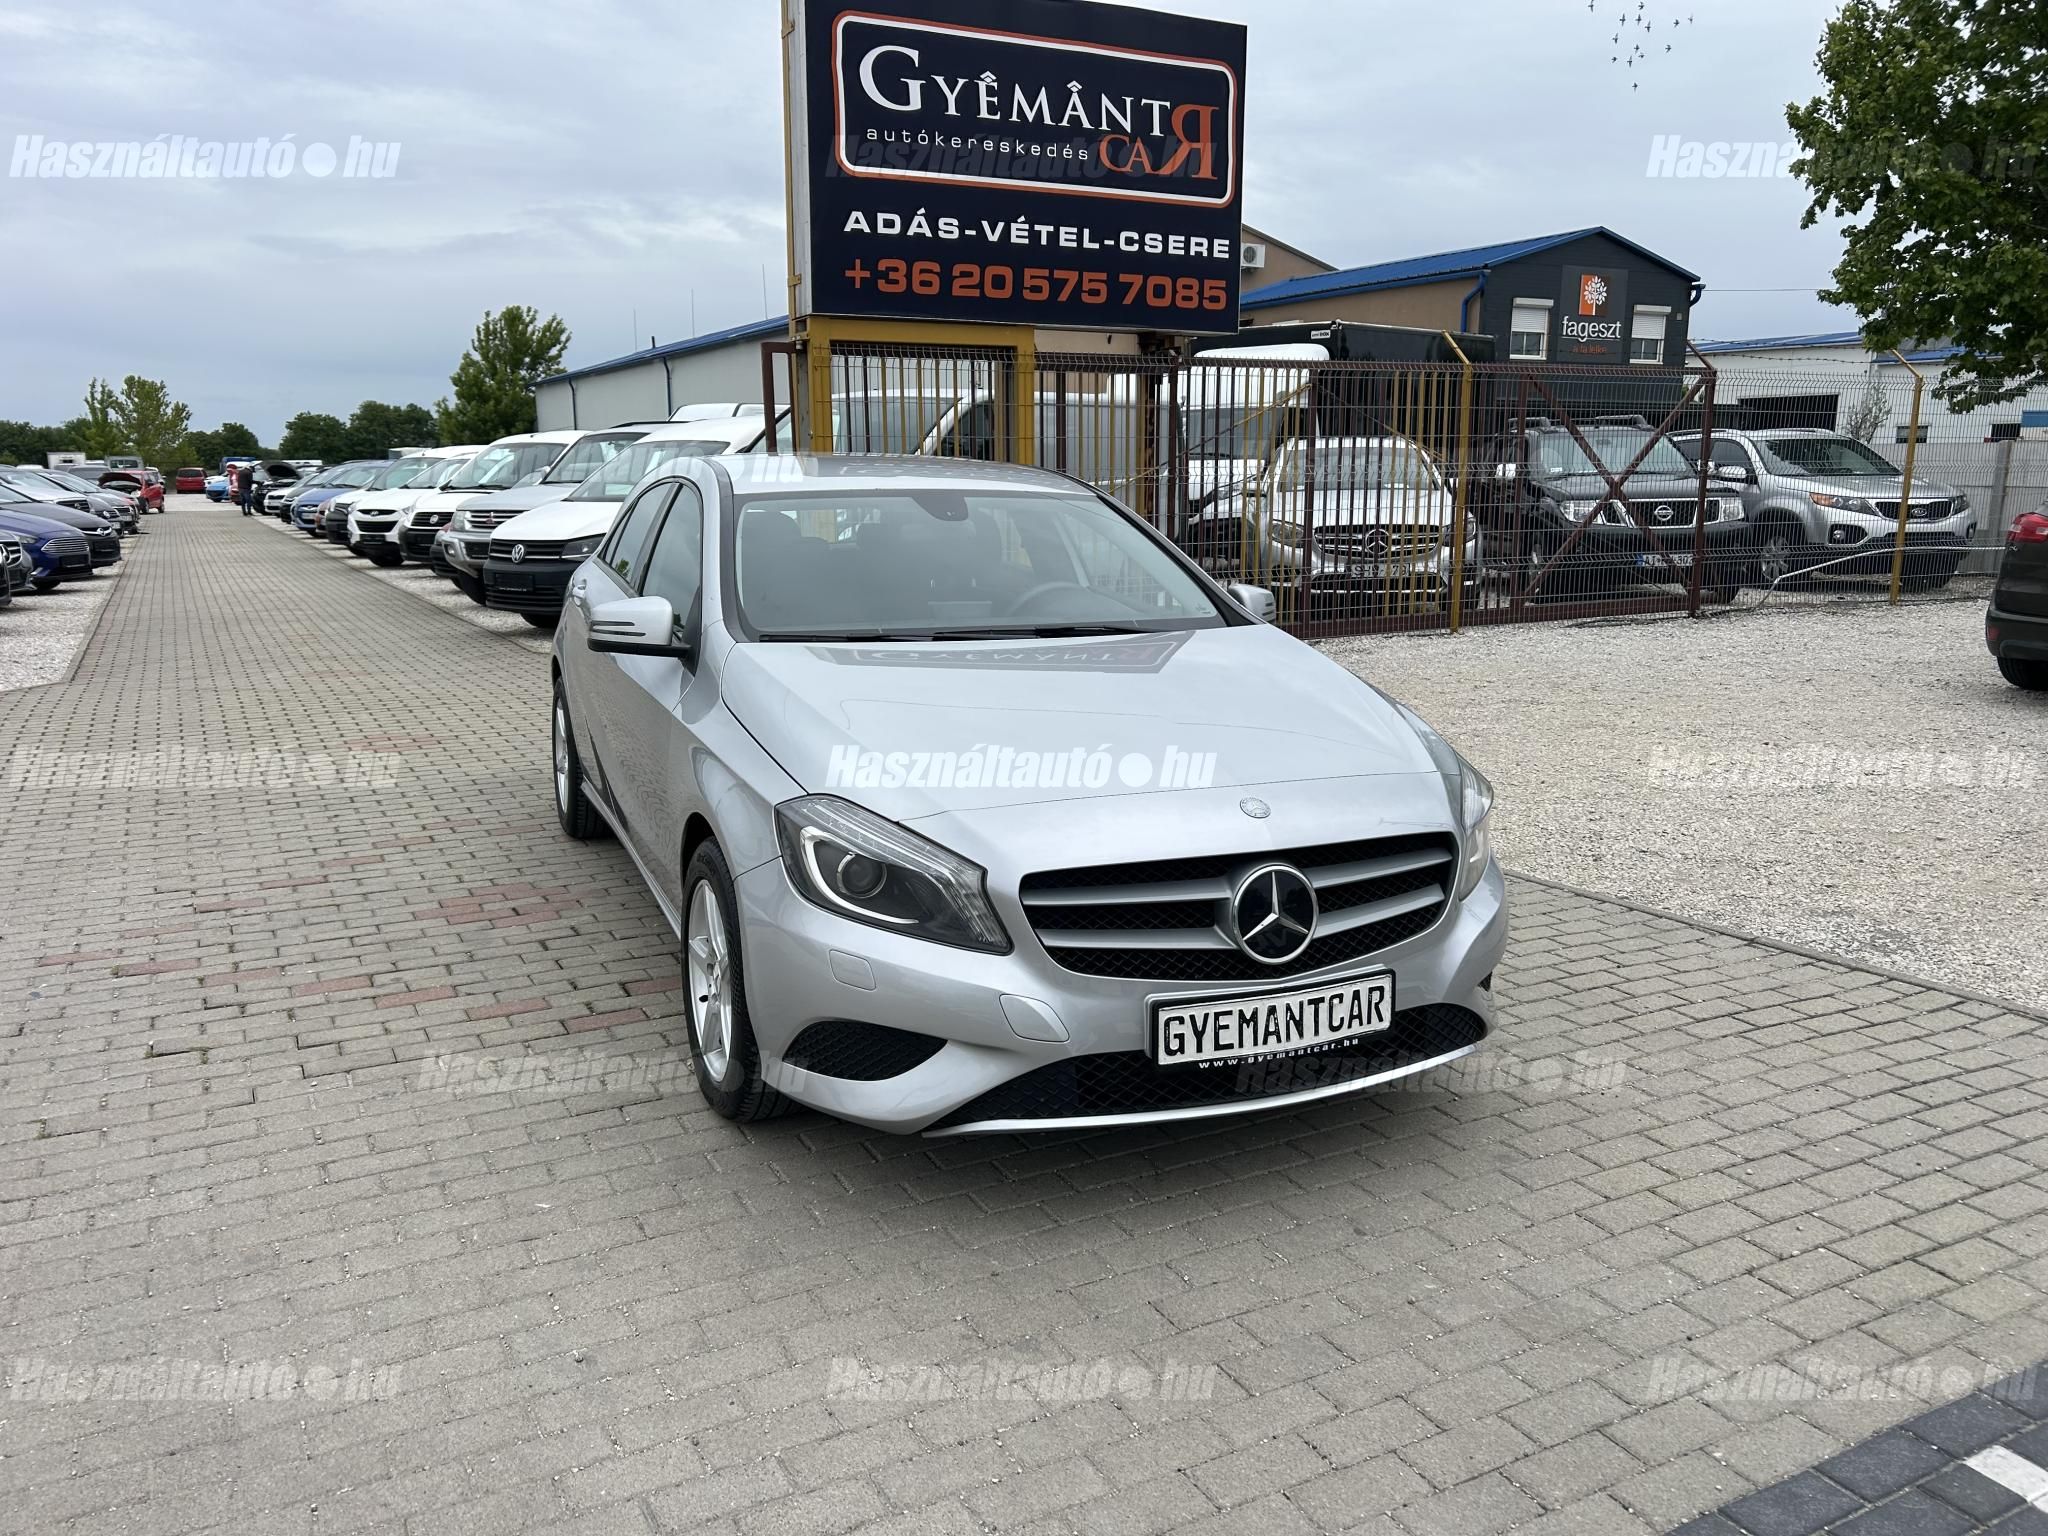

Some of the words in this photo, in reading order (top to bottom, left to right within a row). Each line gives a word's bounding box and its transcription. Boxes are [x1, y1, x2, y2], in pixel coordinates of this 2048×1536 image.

[867, 127, 1089, 161] autókereskedés
[843, 207, 1230, 260] ADÁS-VÉTEL-CSERE
[844, 258, 942, 296] +36
[951, 263, 1014, 300] 20
[1022, 268, 1108, 305] 575
[1118, 273, 1228, 311] 7085
[1562, 315, 1622, 342] fageszt
[1163, 985, 1385, 1056] GYEMANTCAR
[1198, 1038, 1360, 1069] www.gyemantcar.hu
